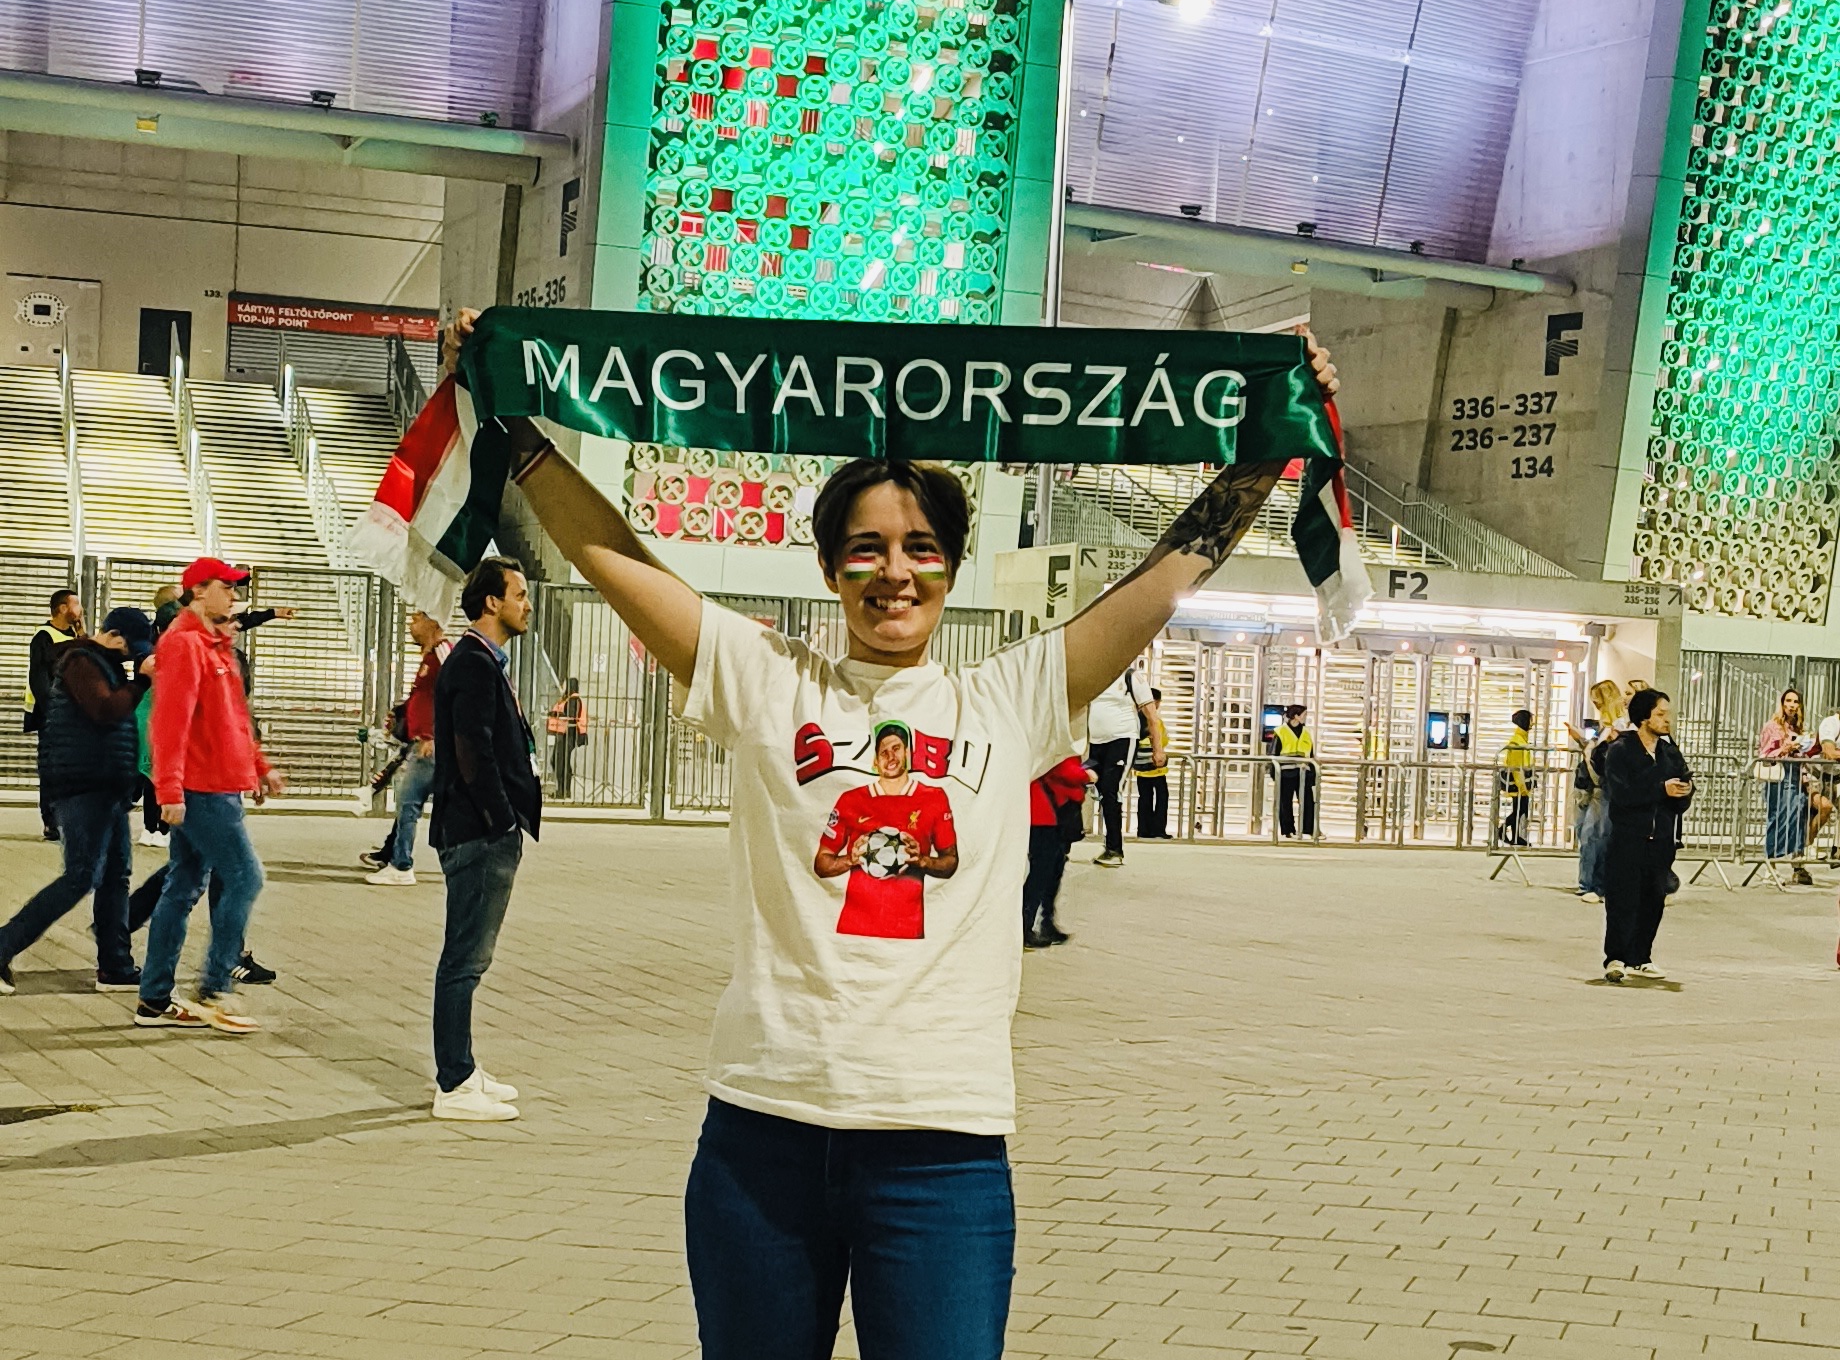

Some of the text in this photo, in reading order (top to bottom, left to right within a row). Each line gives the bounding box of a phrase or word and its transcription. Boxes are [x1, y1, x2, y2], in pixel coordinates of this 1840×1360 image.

[560, 177, 580, 257] F
[237, 303, 275, 315] KÁRTYA
[237, 314, 309, 328] TOP-UP POINT
[1545, 312, 1583, 376] F
[522, 339, 1248, 428] MAGYARORSZÁG
[1511, 456, 1554, 479] 134
[1107, 573, 1124, 581] 13
[1389, 570, 1429, 600] F2
[1644, 607, 1659, 615] 134
